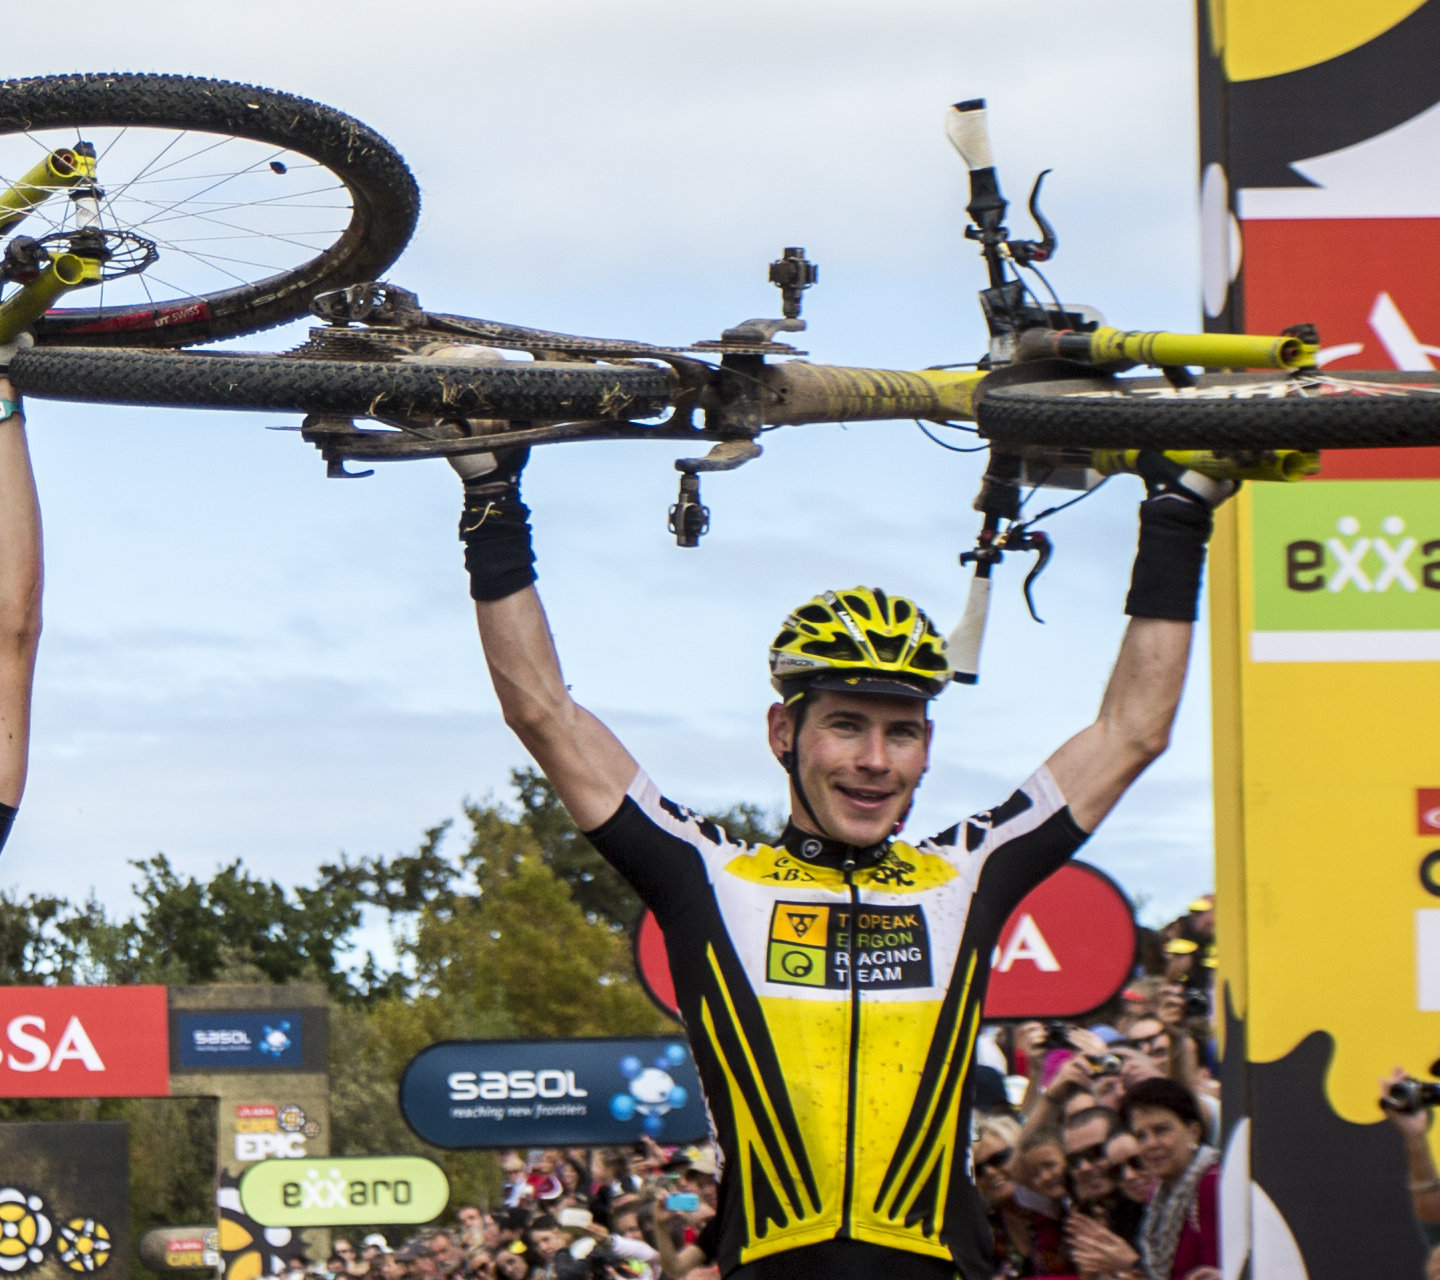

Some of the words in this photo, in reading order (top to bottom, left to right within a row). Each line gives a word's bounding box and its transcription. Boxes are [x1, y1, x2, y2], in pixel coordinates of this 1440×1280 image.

[837, 912, 919, 931] TOPEAK
[836, 931, 914, 949] ERGON
[834, 947, 923, 967] RACING
[833, 966, 903, 984] TEAM
[234, 1132, 307, 1162] EPIC
[281, 1168, 412, 1208] exxaro
